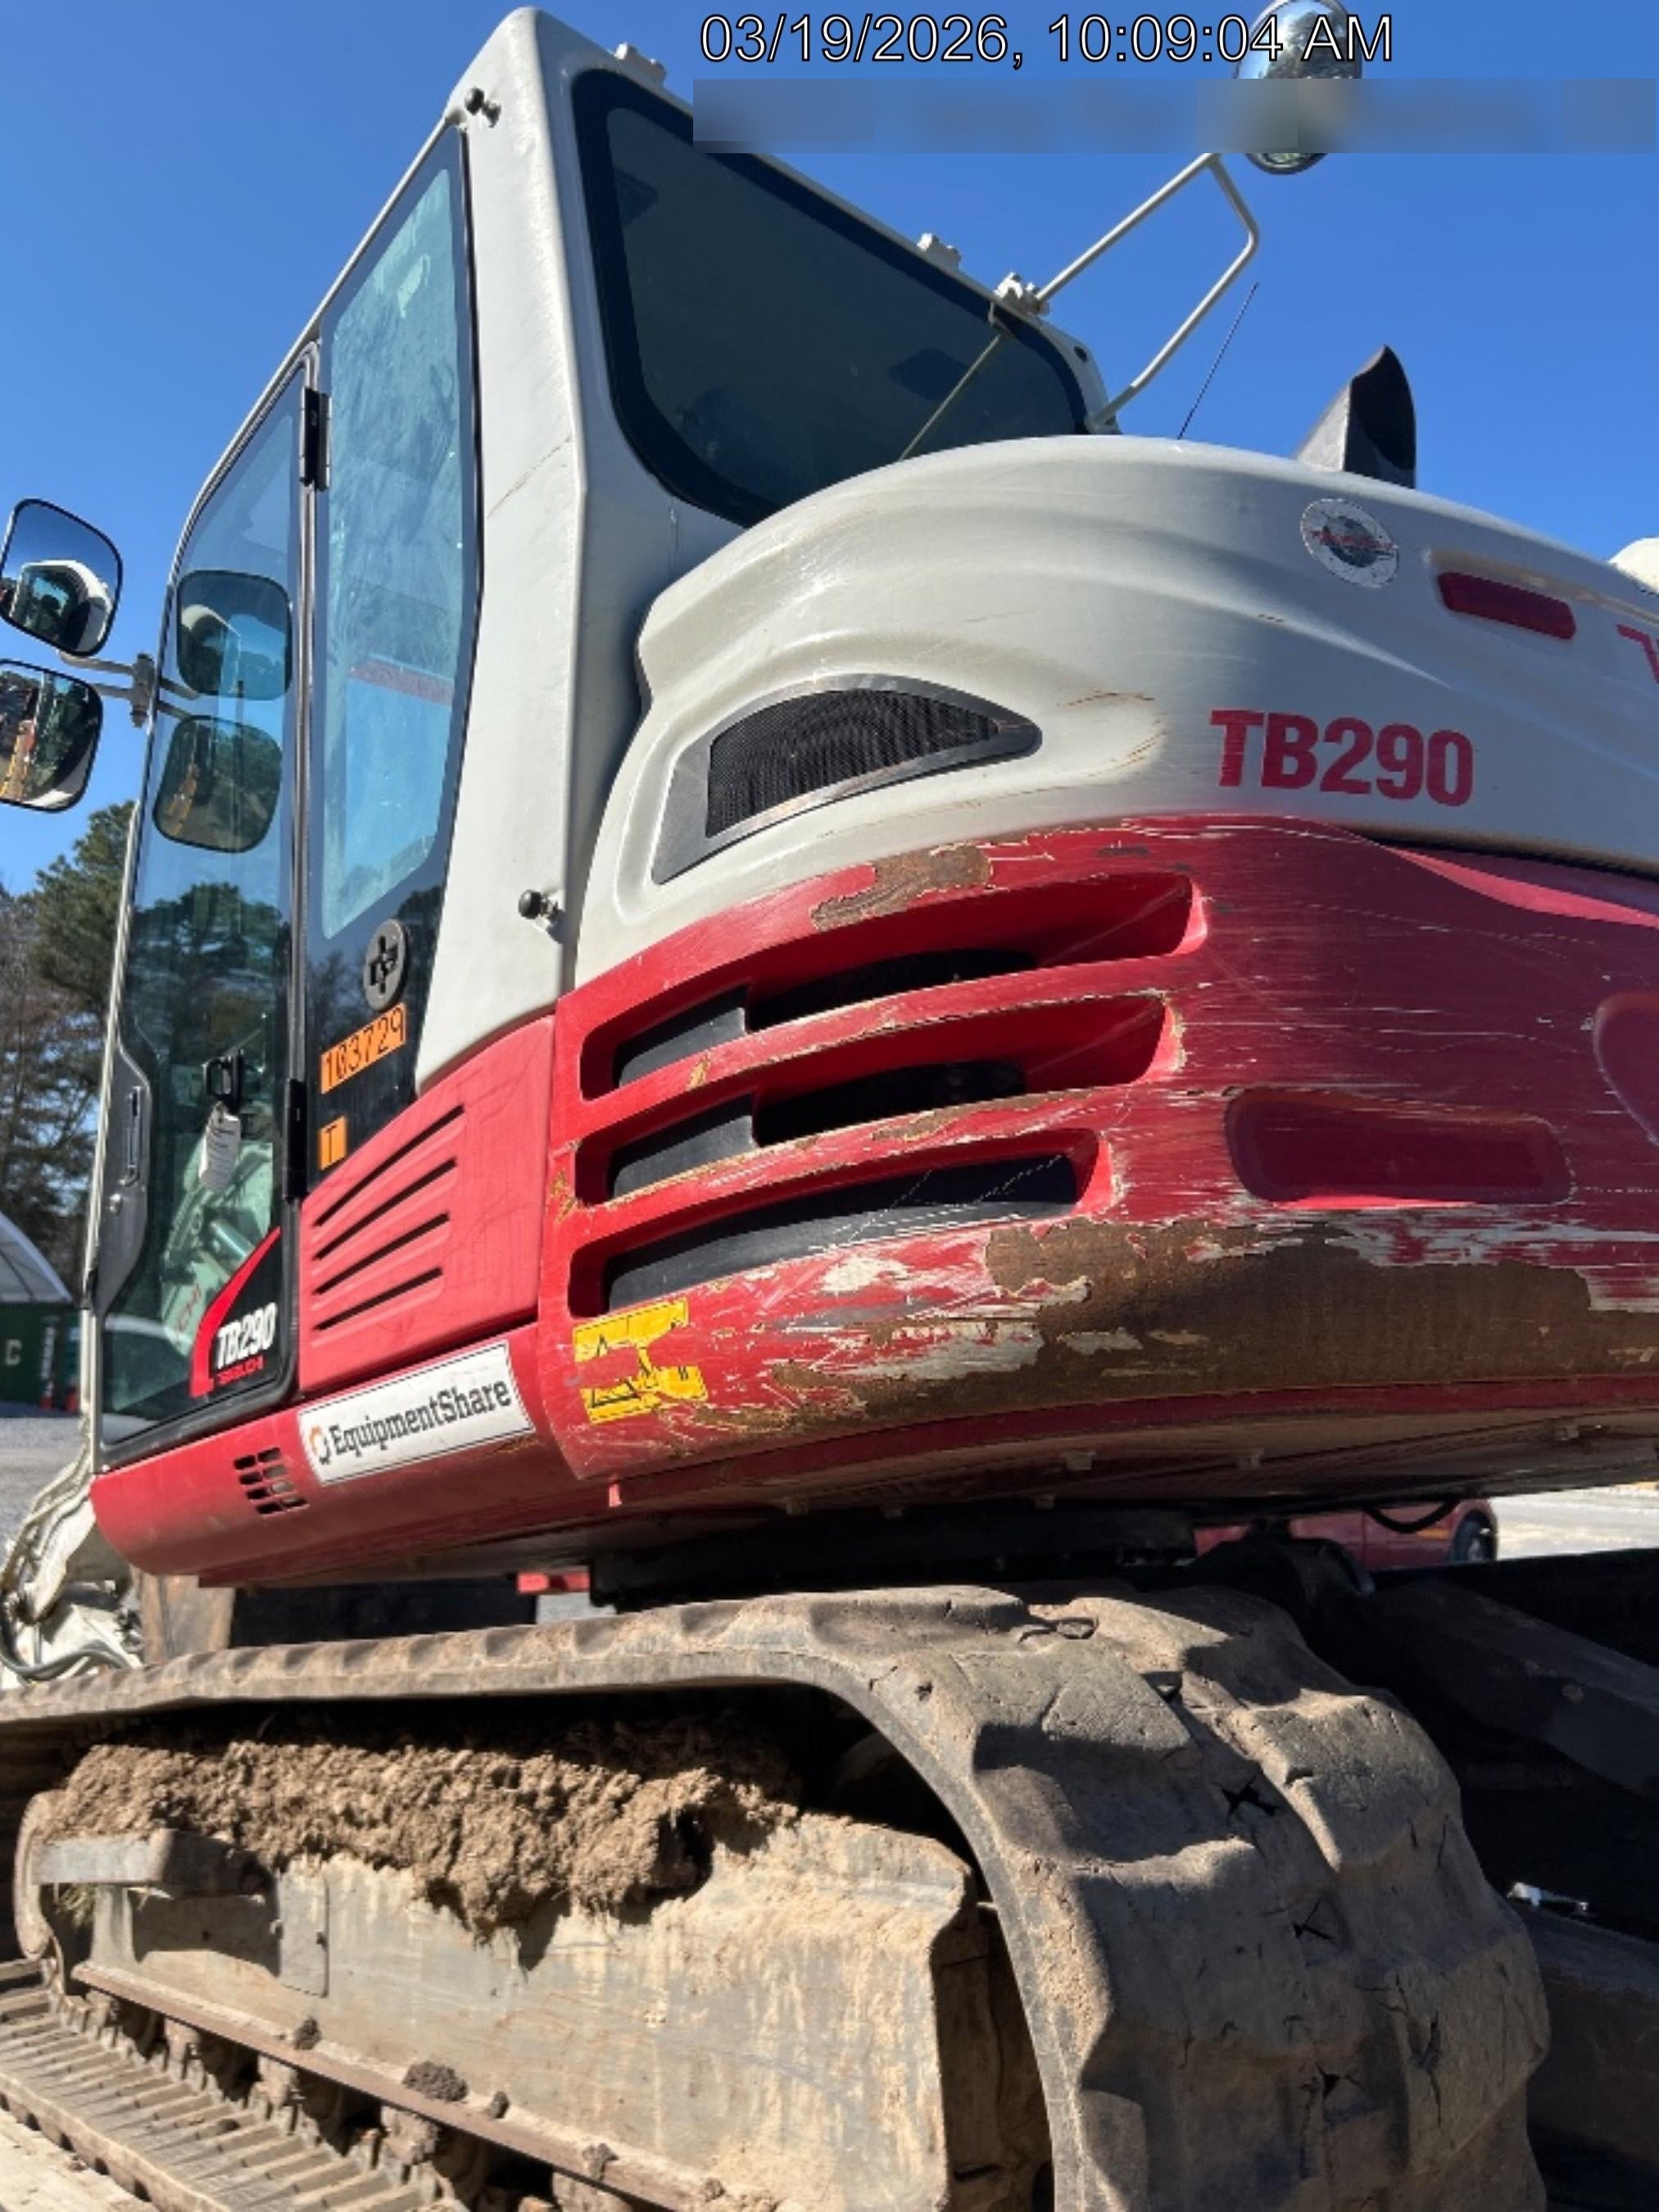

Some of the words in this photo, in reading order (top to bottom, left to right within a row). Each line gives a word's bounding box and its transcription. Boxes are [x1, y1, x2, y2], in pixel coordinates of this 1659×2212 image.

[1210, 709, 1473, 807] TB290
[217, 1302, 277, 1370] TB290
[329, 1380, 512, 1457] EquipmentShare
